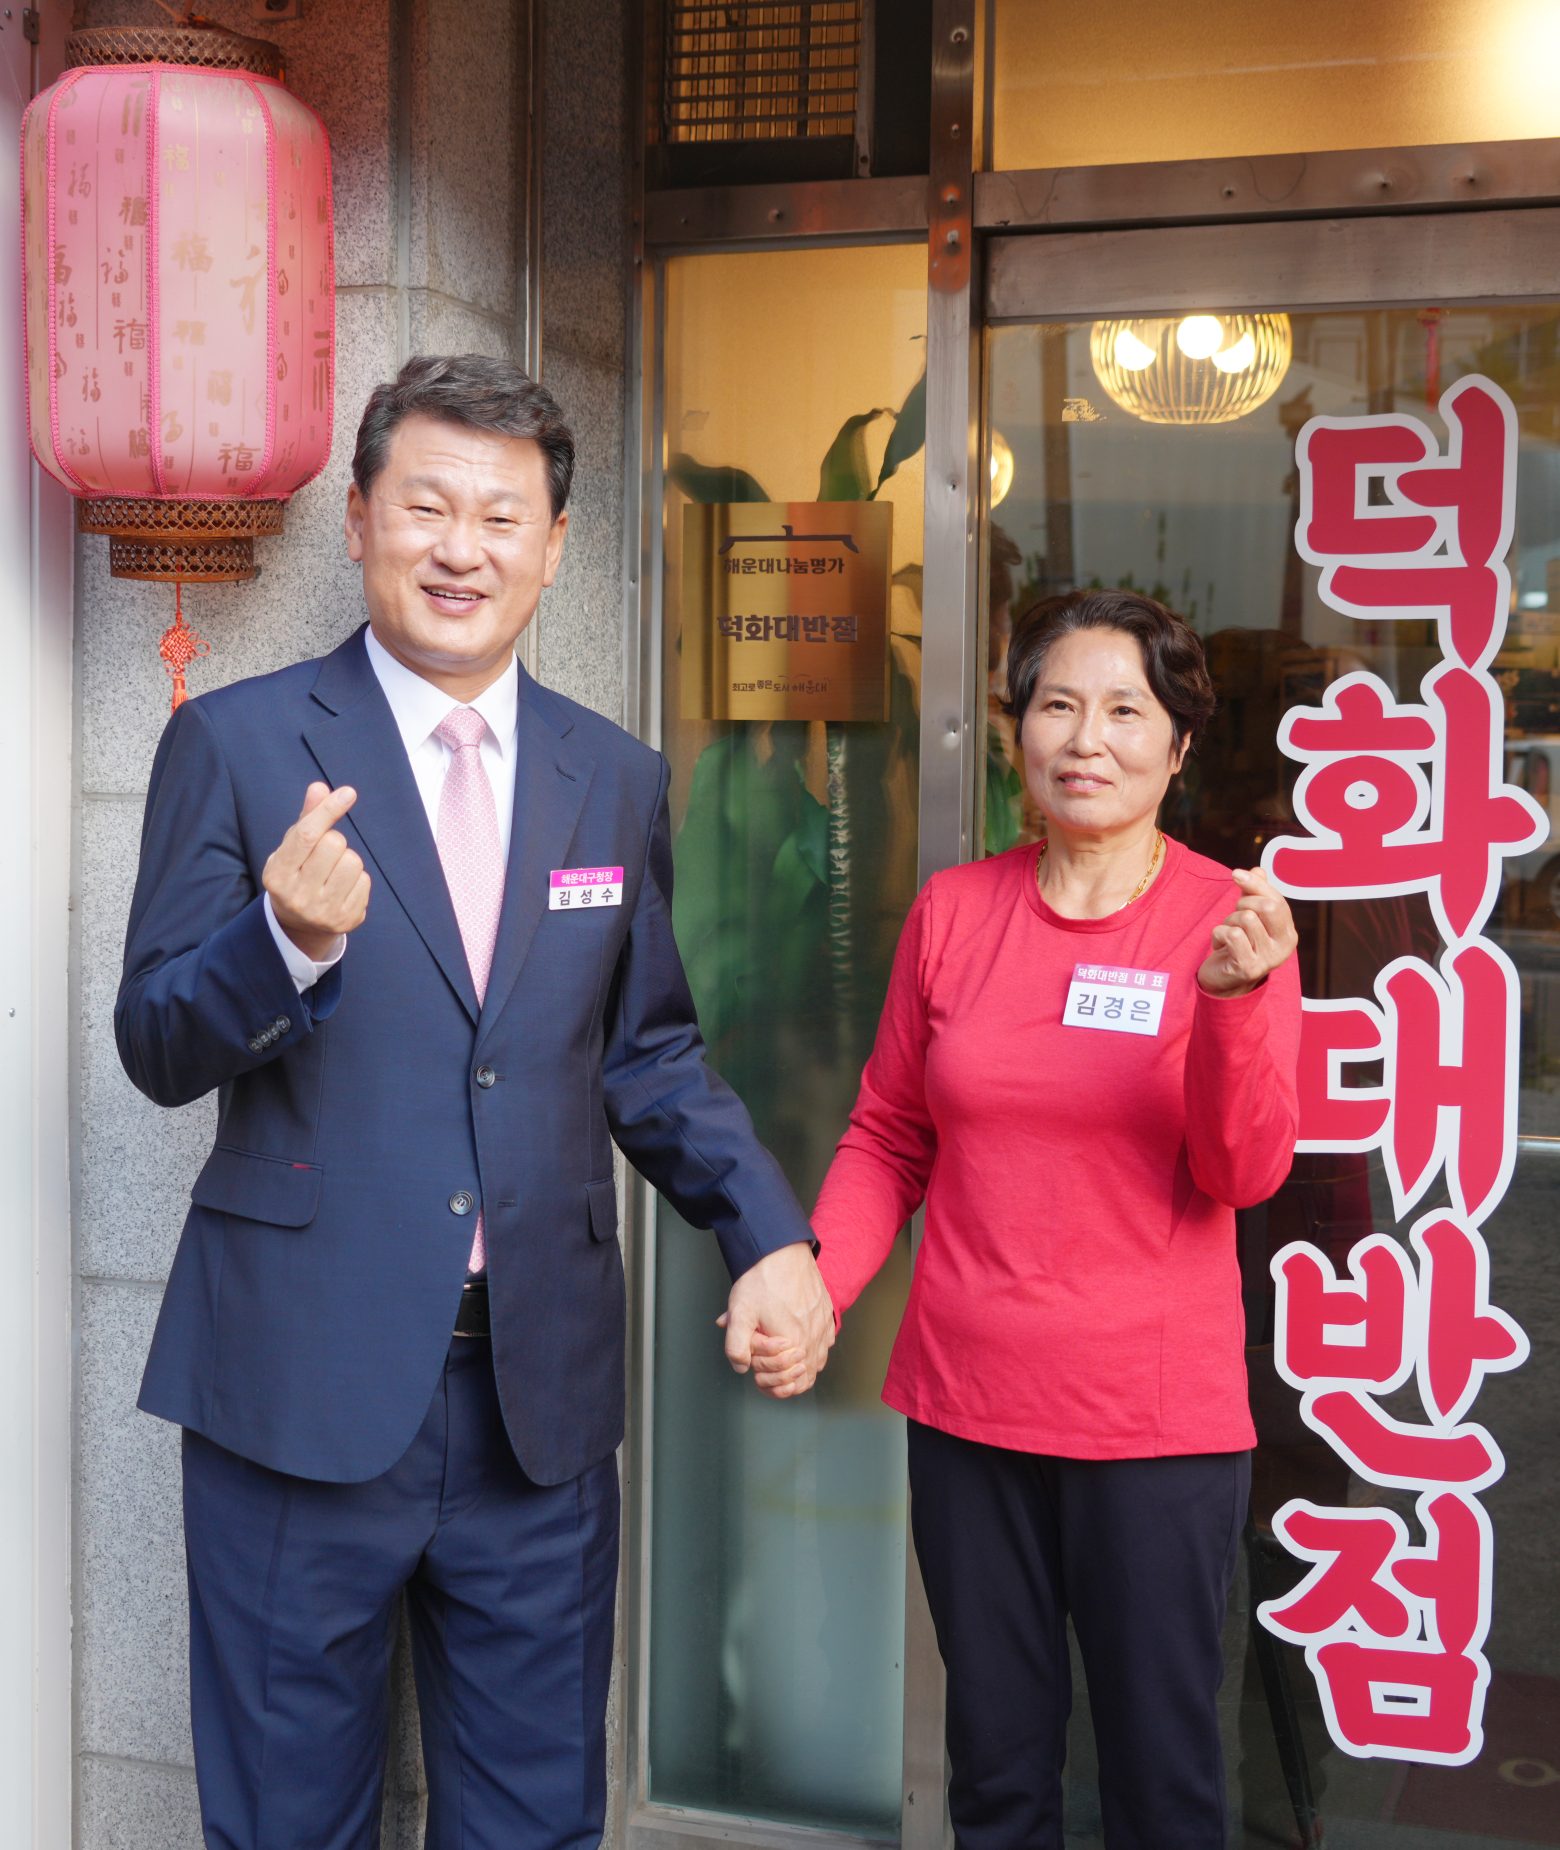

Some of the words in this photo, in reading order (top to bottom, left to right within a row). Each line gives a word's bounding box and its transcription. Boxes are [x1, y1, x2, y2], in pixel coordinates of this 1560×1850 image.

[113, 318, 149, 354] 福
[217, 442, 261, 475] 福
[723, 558, 845, 575] 해운대나눔명가
[561, 871, 614, 885] 해운대구청장
[1077, 967, 1129, 984] 덕화대반점
[1076, 993, 1151, 1022] 김경은
[1257, 373, 1550, 1768] 덕화대반점
